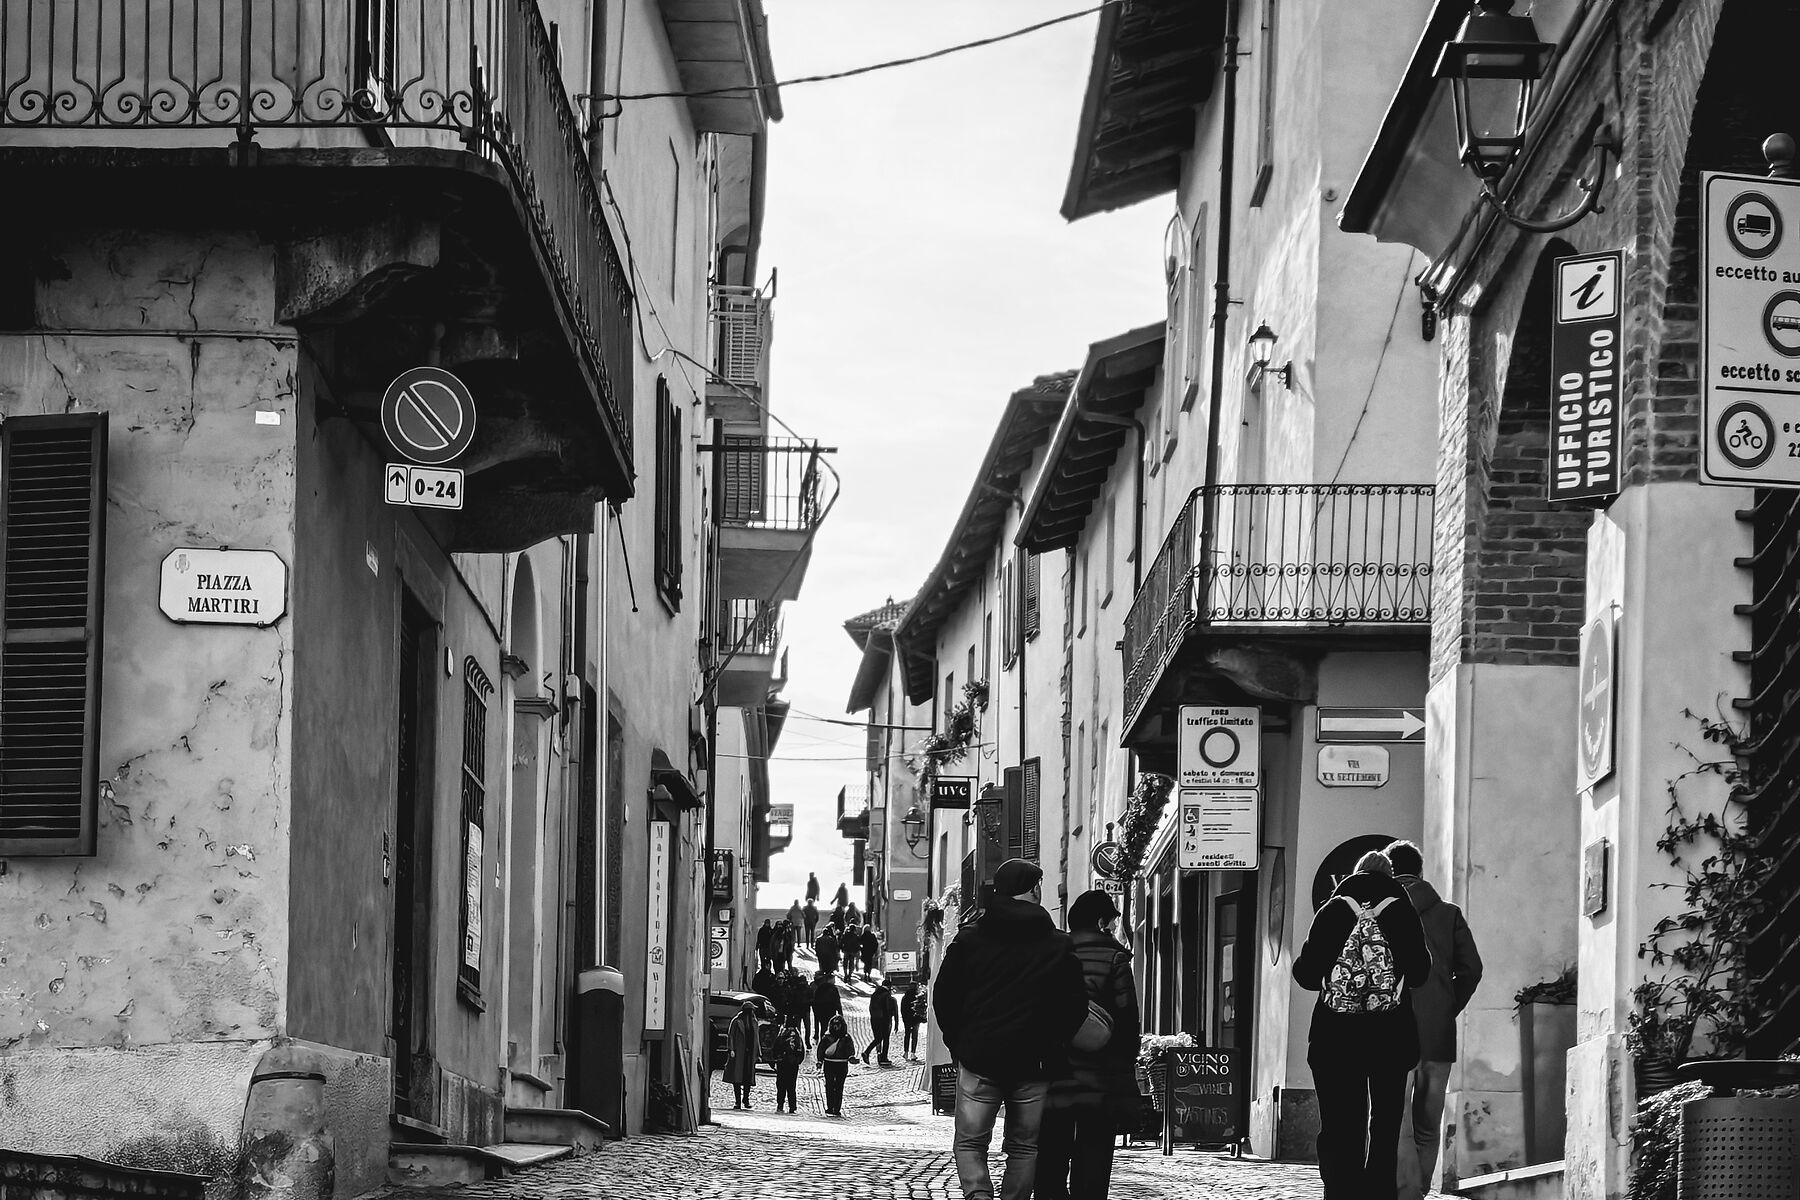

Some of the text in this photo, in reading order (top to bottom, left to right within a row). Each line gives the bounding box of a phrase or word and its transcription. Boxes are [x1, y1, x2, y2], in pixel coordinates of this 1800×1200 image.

[1715, 266, 1777, 282] eccetto
[1720, 363, 1780, 382] eccetto
[1587, 329, 1614, 487] TURISTICO
[1557, 372, 1583, 489] UFFICIO
[414, 478, 456, 499] 0-24
[197, 574, 252, 591] PIAZZA
[188, 597, 259, 614] MARTIRI
[1220, 717, 1253, 726] limitato
[1176, 1053, 1229, 1064] VICINO
[1191, 1064, 1229, 1075] VINO
